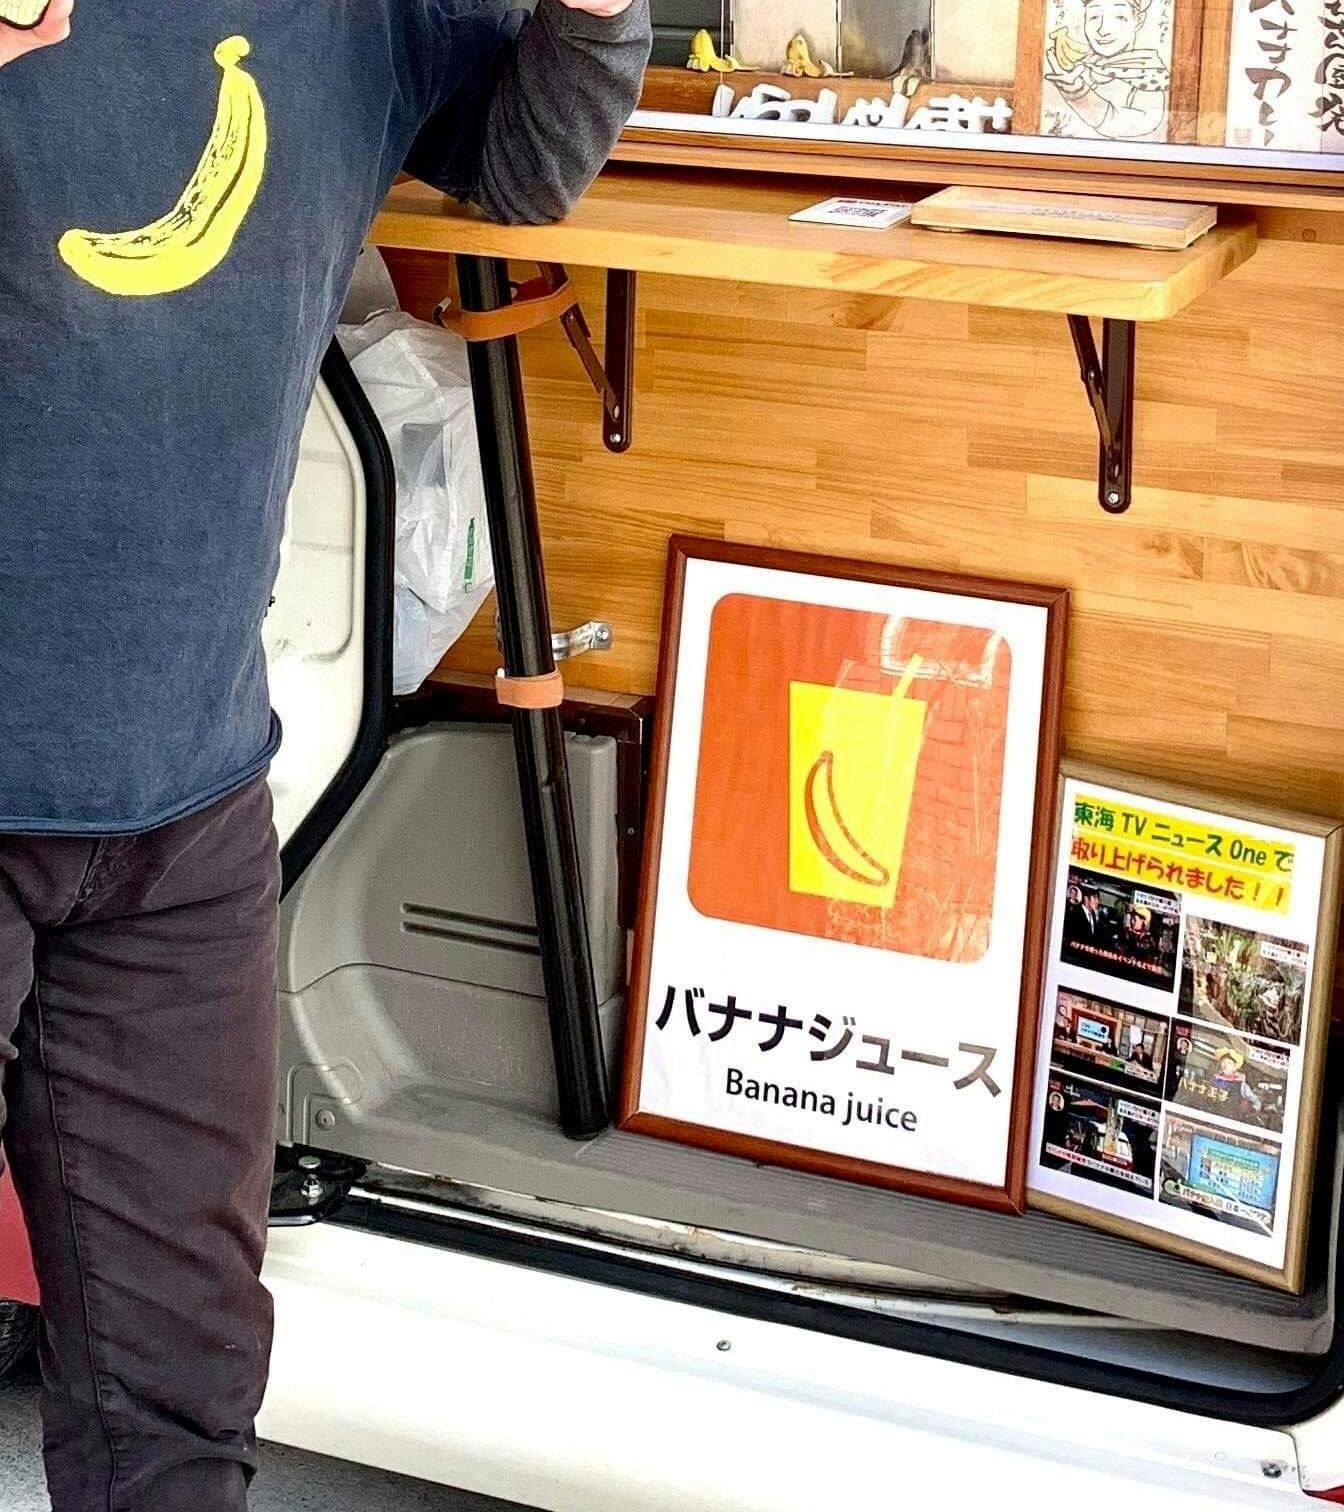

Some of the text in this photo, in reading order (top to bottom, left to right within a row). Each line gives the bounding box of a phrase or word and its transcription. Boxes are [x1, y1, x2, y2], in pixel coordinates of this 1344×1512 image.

[1073, 801, 1295, 873] 東海 TV ニュース One で
[654, 983, 1002, 1098] バナナジュース
[724, 1067, 919, 1134] Banana juice
